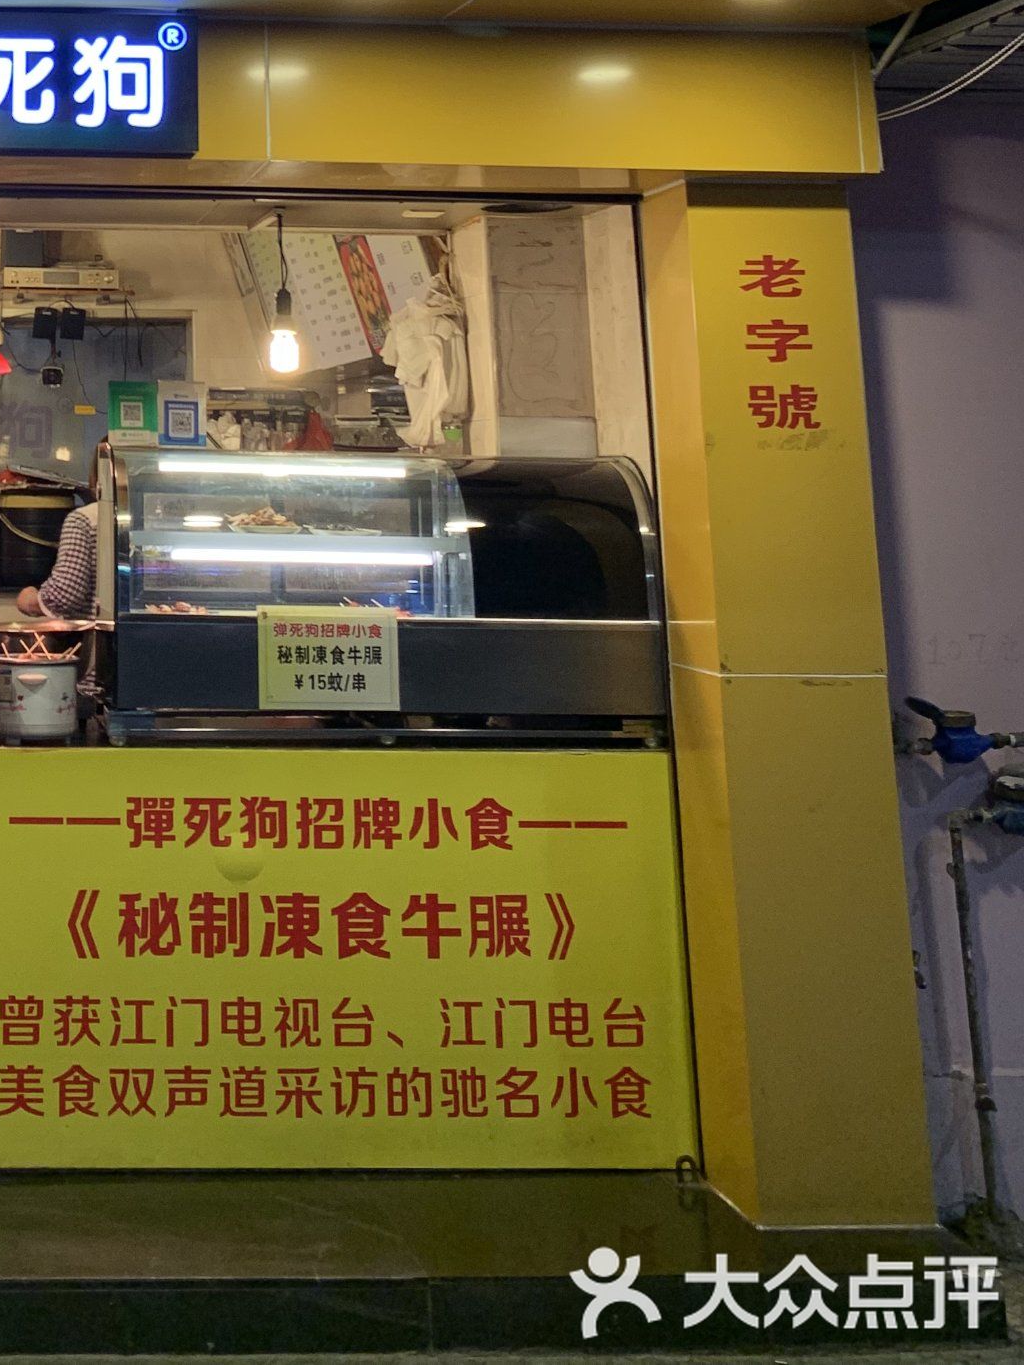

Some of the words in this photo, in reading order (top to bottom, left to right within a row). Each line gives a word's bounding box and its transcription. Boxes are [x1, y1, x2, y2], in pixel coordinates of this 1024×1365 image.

[738, 254, 822, 430] 老字號
[273, 622, 383, 639] 弹死狗招牌小食
